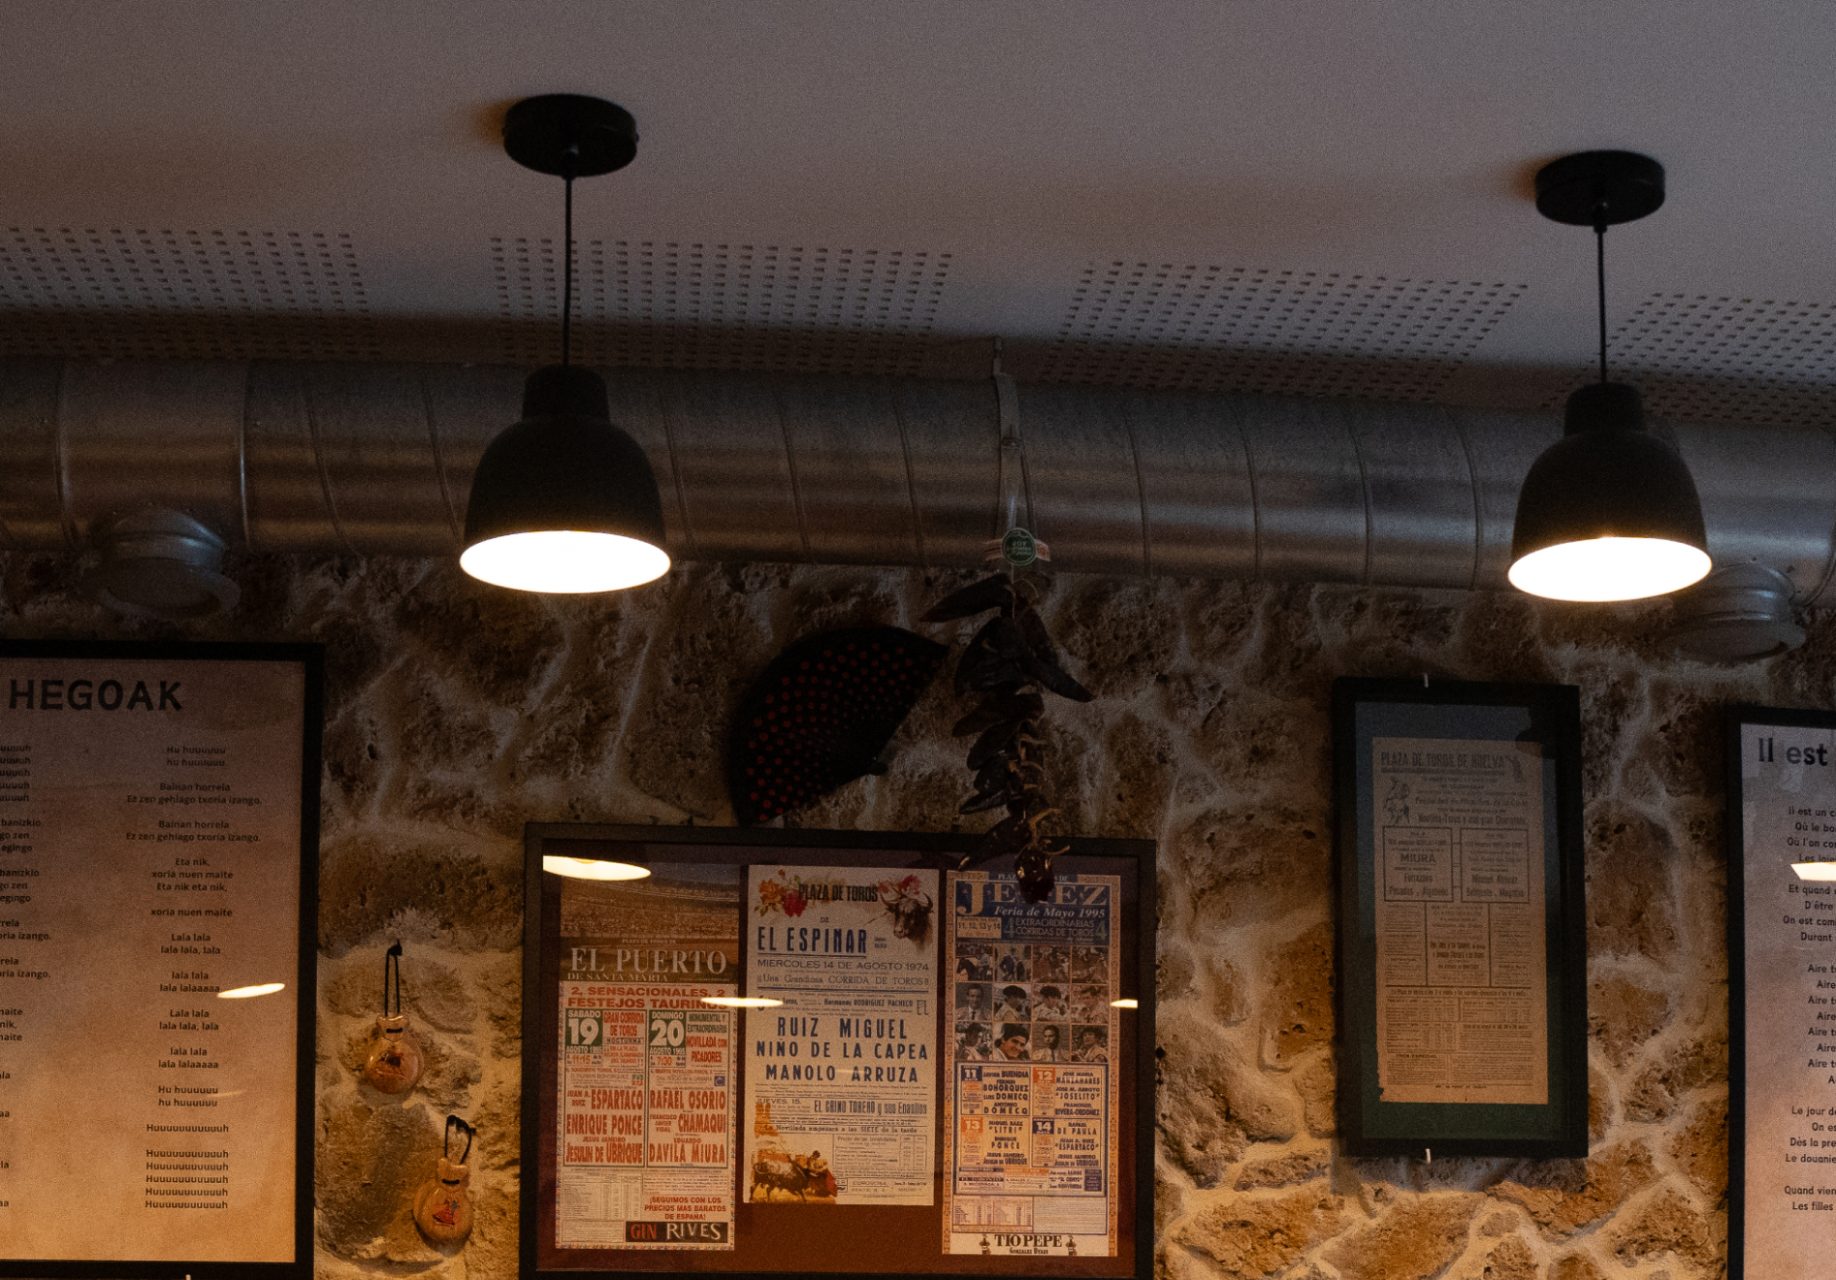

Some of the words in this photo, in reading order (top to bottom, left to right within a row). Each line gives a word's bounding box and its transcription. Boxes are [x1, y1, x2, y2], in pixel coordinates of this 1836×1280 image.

[9, 679, 183, 711] HEGOAK
[1758, 737, 1774, 762] Il
[1786, 743, 1828, 767] est
[1400, 852, 1437, 864] MIURA
[799, 884, 829, 901] PLAZA
[832, 885, 844, 901] DE
[846, 886, 878, 902] TOROS
[1788, 884, 1799, 893] Et
[1802, 885, 1831, 896] quand
[956, 881, 1107, 917] JEEZ
[994, 906, 1024, 917] Feria
[1026, 906, 1040, 917] de
[1043, 908, 1075, 920] Mayo
[1080, 909, 1105, 918] 1995
[1783, 915, 1795, 924] On
[1798, 917, 1813, 925] est
[758, 926, 777, 951] EL
[787, 927, 867, 953] ESPINAR
[1800, 932, 1832, 942] Durant
[571, 947, 604, 972] EL
[617, 949, 727, 975] PUERTO
[757, 959, 820, 969] MIERCOLES
[823, 961, 834, 969] 14
[838, 961, 853, 970] DE
[857, 962, 903, 971] AGOSTO
[905, 963, 929, 972] 1974
[1807, 964, 1827, 973] Aire
[567, 973, 583, 981] DE
[828, 975, 870, 985] CORRIDA
[875, 976, 888, 985] DE
[568, 998, 645, 1008] FESTEJOS
[1808, 996, 1828, 1005] Aire
[568, 1010, 601, 1019] SABADO
[568, 1018, 599, 1046] 19
[650, 1020, 685, 1047] 20
[778, 1017, 819, 1038] RUIZ
[840, 1018, 907, 1039] MIGUEL
[1808, 1028, 1828, 1037] Aire
[811, 1042, 831, 1058] DE
[843, 1042, 862, 1059] LA
[875, 1043, 928, 1060] CAPEA
[1807, 1059, 1828, 1068] Aire
[766, 1064, 835, 1081] MANOLO
[851, 1066, 918, 1083] ARRUZA
[964, 1069, 977, 1080] 11
[1037, 1071, 1052, 1081] 12
[592, 1089, 643, 1110] ESPARTACO
[650, 1090, 684, 1110] RAFAEL
[689, 1090, 726, 1110] OSORIO
[1791, 1105, 1803, 1115] Le
[1806, 1106, 1825, 1117] jour
[567, 1114, 607, 1135] ENRIQUE
[612, 1114, 642, 1136] PONCE
[678, 1113, 726, 1133] CHAMAQUI
[966, 1120, 980, 1131] 13
[1036, 1121, 1052, 1131] 14
[1811, 1122, 1824, 1131] On
[1810, 1138, 1818, 1147] la
[595, 1146, 604, 1163] DE
[650, 1143, 686, 1163] DAVILA
[692, 1143, 725, 1163] MIURA
[1785, 1153, 1797, 1162] Le
[1784, 1186, 1814, 1196] Quand
[1792, 1202, 1809, 1211] Les
[1811, 1201, 1834, 1211] filles
[630, 1224, 657, 1240] GIN
[666, 1222, 721, 1241] RIVES
[994, 1234, 1021, 1248] TIO
[1023, 1234, 1062, 1249] PEPE
